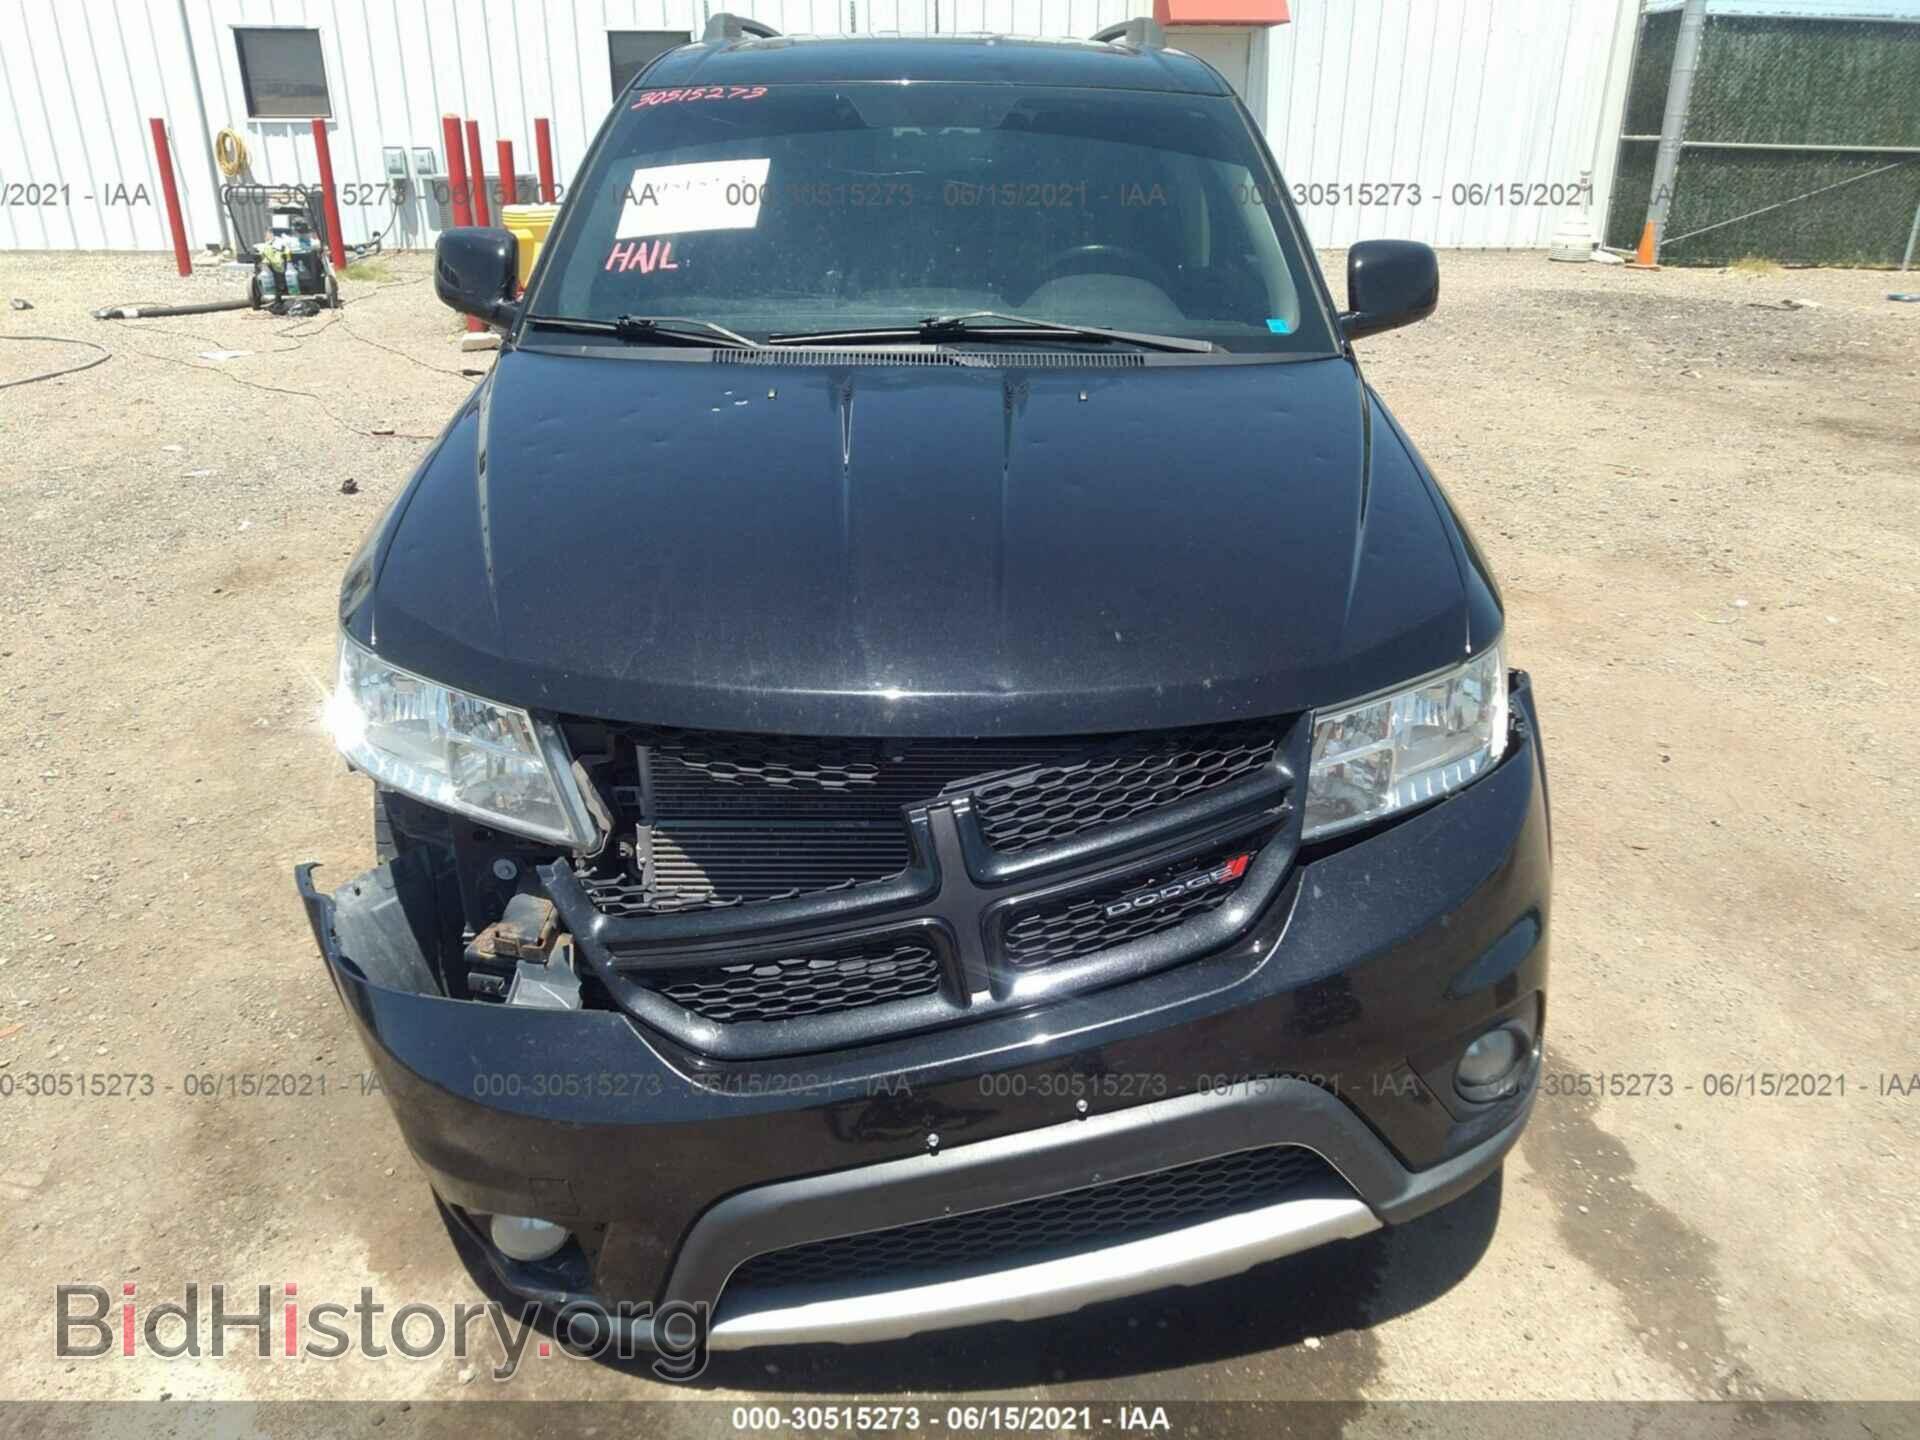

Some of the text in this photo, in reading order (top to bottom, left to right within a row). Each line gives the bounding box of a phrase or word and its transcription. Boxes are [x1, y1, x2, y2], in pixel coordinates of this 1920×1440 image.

[631, 86, 768, 109] 30515273
[605, 240, 678, 274] HAIL
[1106, 865, 1233, 916] DODGE
